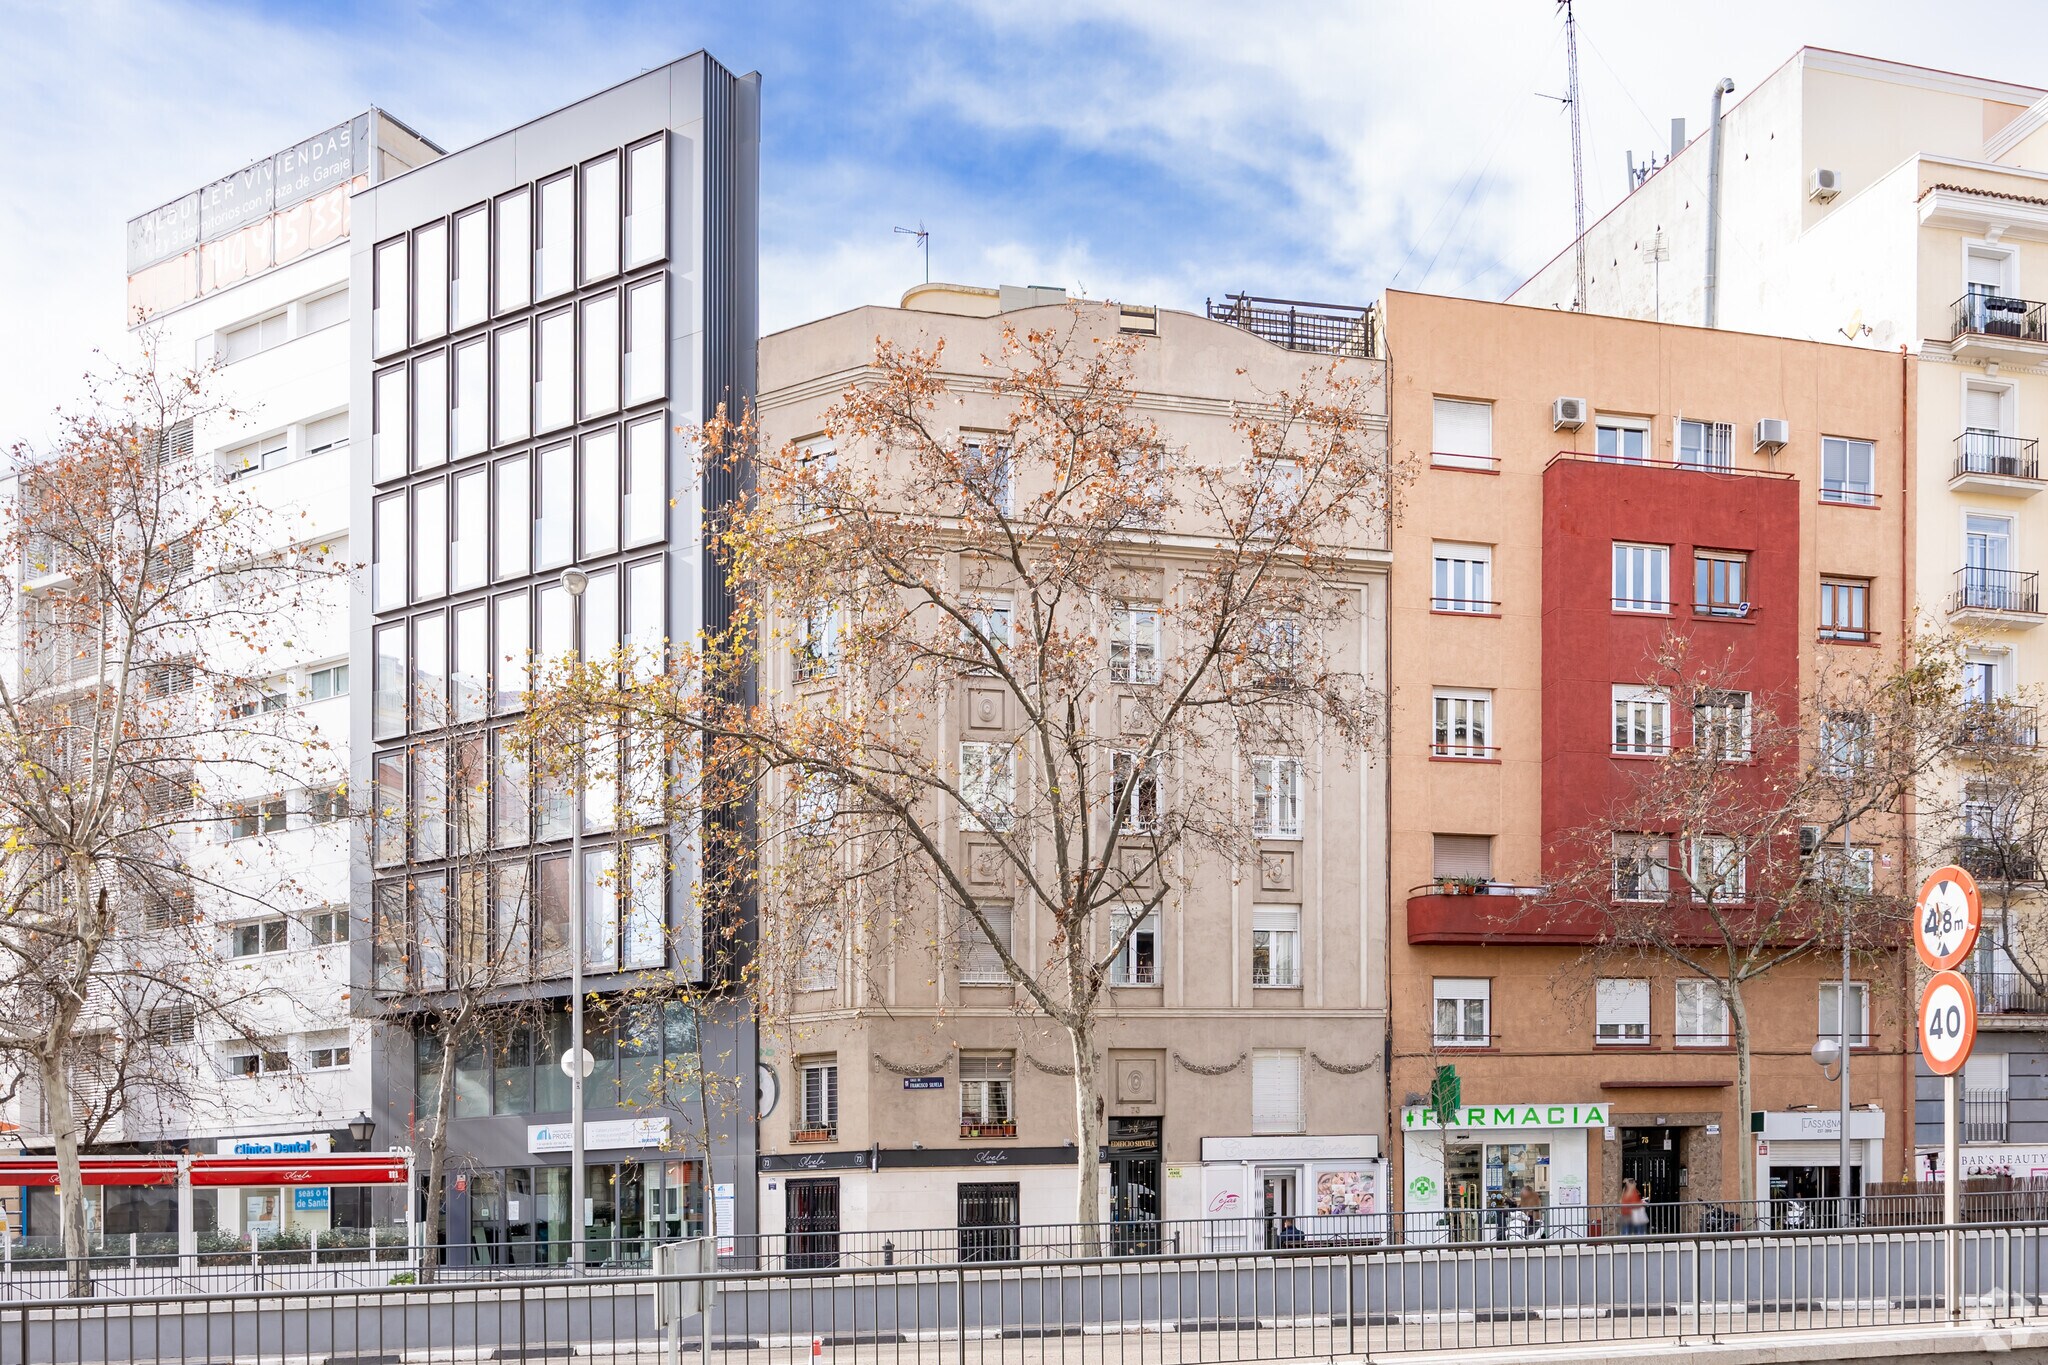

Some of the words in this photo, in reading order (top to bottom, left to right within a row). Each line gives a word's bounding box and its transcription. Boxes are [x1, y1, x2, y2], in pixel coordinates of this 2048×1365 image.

[144, 182, 235, 233] ALQUILER
[244, 129, 351, 190] VIVIENDAS
[181, 206, 240, 239] dormitorios
[242, 195, 262, 213] con
[265, 183, 293, 206] Plaza
[295, 173, 310, 191] de
[313, 157, 351, 182] Garaje
[1929, 1005, 1961, 1039] 40
[273, 1140, 311, 1153] Dental
[1110, 1140, 1134, 1148] EDIFICIO
[1134, 1140, 1156, 1148] SILVELA
[2000, 1153, 2047, 1165] BEAUTY
[298, 1189, 315, 1198] seas
[315, 1189, 321, 1197] o
[296, 1199, 306, 1208] de
[1209, 1190, 1238, 1212] Cejas
